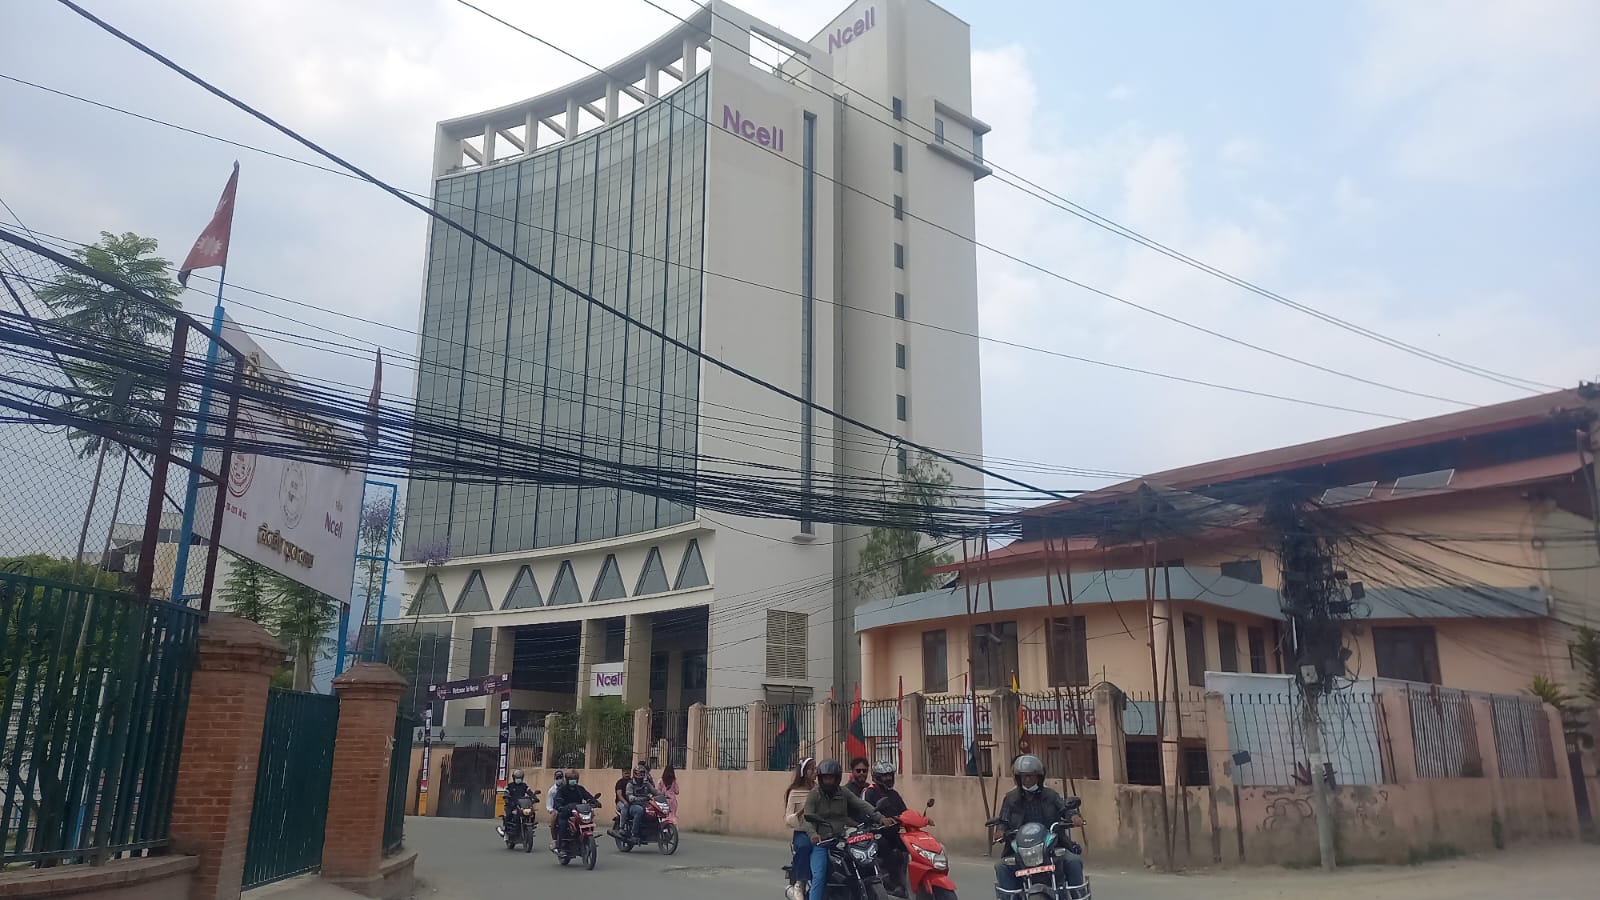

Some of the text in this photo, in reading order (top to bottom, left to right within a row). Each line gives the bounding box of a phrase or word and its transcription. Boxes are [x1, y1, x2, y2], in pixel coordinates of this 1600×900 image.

[828, 6, 876, 55] Ncell
[722, 104, 785, 152] Ncell
[324, 511, 344, 540] Ncell
[596, 672, 623, 688] Ncell
